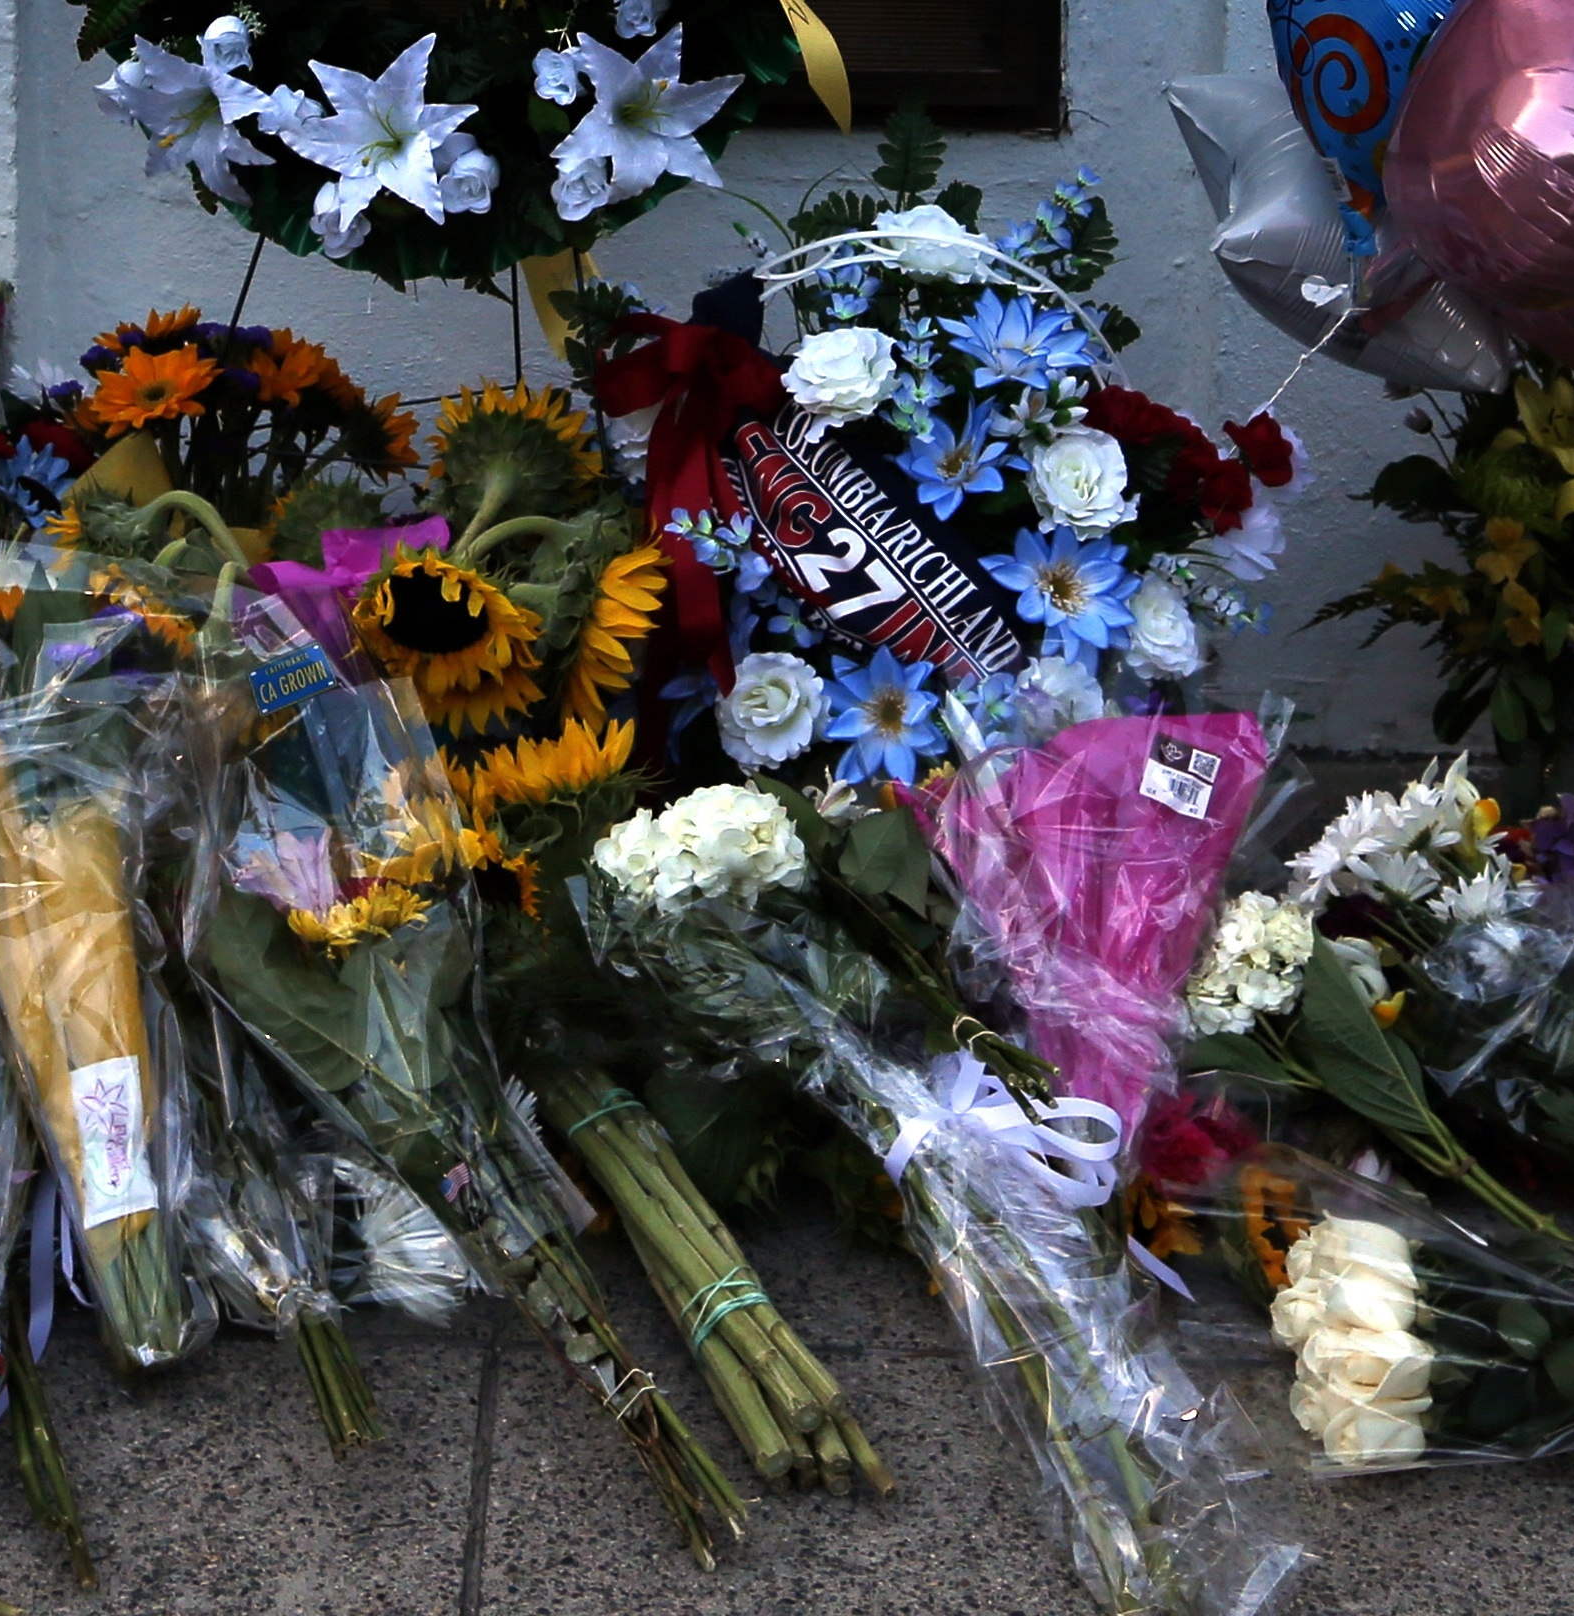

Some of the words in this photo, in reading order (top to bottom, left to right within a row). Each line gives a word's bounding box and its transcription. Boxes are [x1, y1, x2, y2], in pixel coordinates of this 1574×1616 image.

[733, 420, 833, 548] ENG
[794, 527, 908, 621] 27
[774, 399, 1022, 673] COLUMBIA/RICHLAND
[259, 681, 278, 704] CA
[279, 660, 327, 695] GROWN
[264, 652, 310, 676] CALIFORNIA
